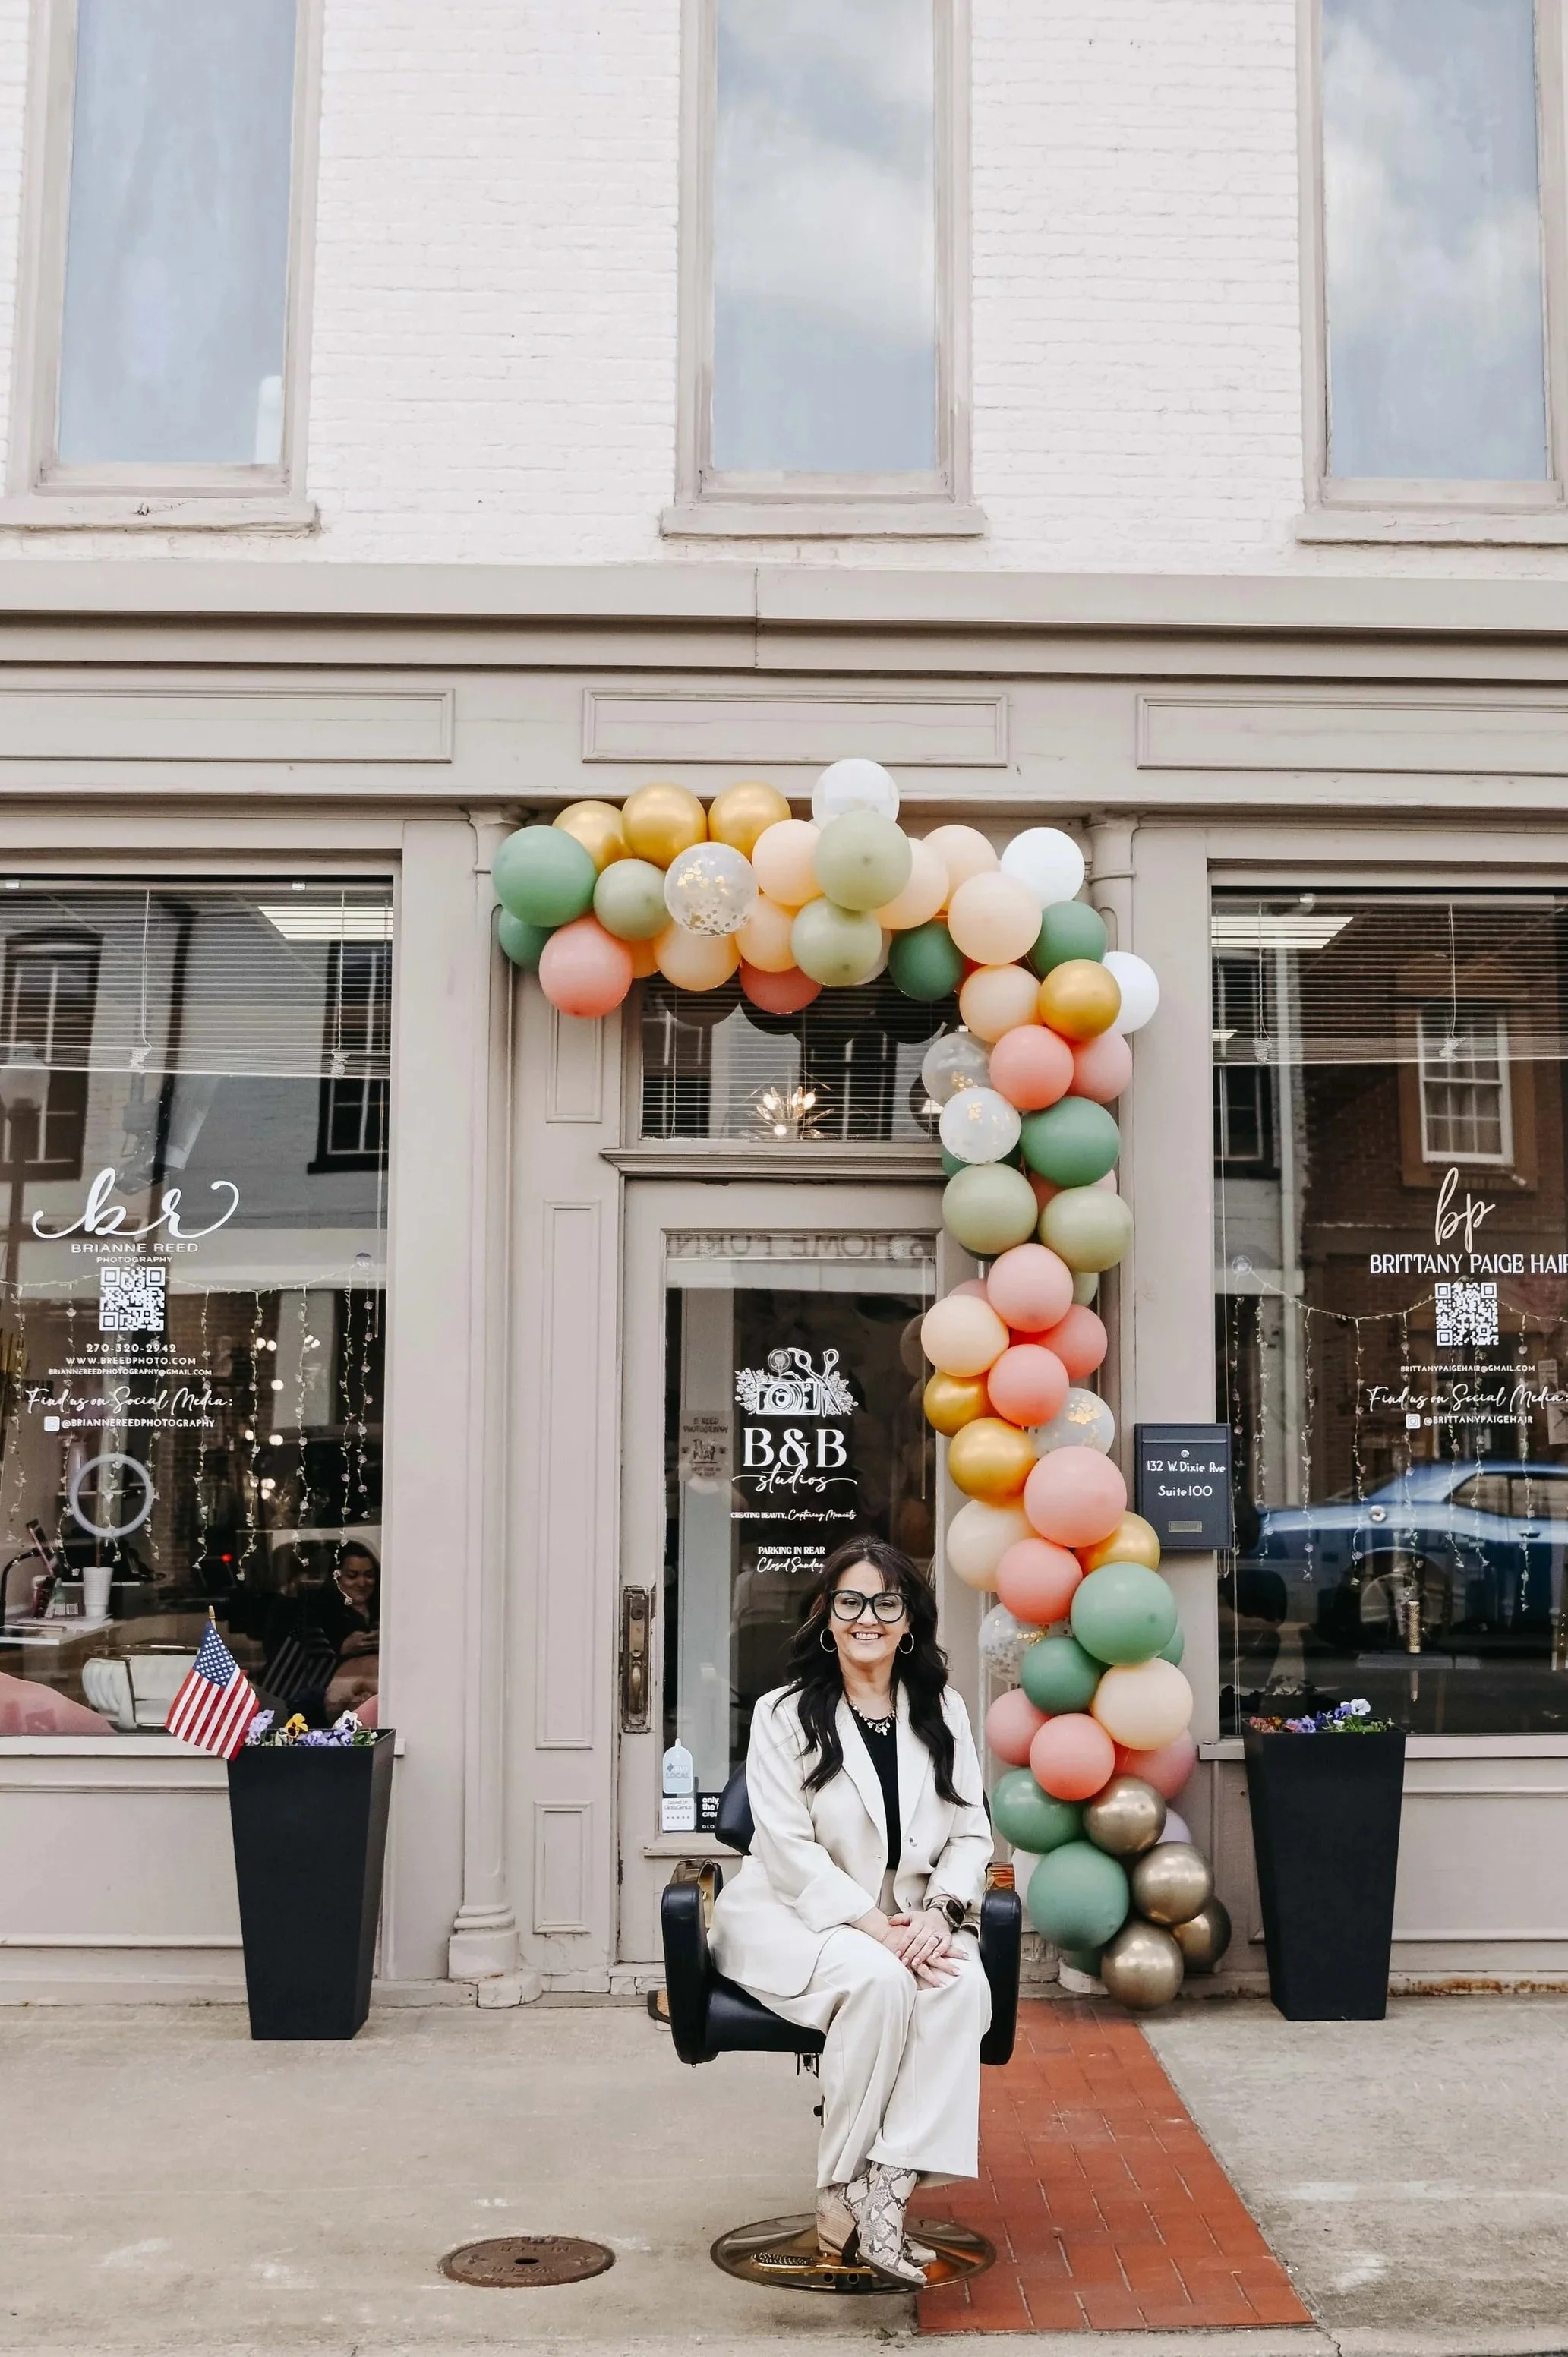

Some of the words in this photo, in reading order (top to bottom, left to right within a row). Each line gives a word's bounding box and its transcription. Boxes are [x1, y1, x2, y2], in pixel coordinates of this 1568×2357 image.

[32, 1167, 240, 1239] br
[1435, 1166, 1496, 1254] bp
[71, 1243, 147, 1253] BRIANNE
[153, 1243, 199, 1253] REED
[1370, 1254, 1462, 1274] BRITTANY
[1470, 1254, 1524, 1274] PAIGE
[86, 1343, 177, 1353] 270-320-2942
[66, 1357, 196, 1365] WWW.BREEDPHOTO.COM
[1400, 1365, 1535, 1373] BRITTANYPAIGEHAIR@GMAIL.COM
[25, 1387, 69, 1414] Find
[69, 1397, 90, 1412] us
[90, 1397, 110, 1406] on
[109, 1386, 168, 1414] Social
[170, 1387, 232, 1415] Media:
[1366, 1385, 1409, 1412] Find
[1409, 1395, 1428, 1409] us
[1430, 1396, 1449, 1405] on
[1451, 1384, 1506, 1411] Social
[62, 1418, 215, 1428] @BRIANNEREEDPHOTOGRAPHY
[1424, 1416, 1533, 1425] @BRITTANYPAIGEHAIR
[743, 1428, 847, 1469] B&B
[1147, 1460, 1163, 1472] 132
[1179, 1461, 1205, 1472] Dixie
[1209, 1462, 1226, 1472] Ave
[732, 1462, 857, 1494] studios
[1157, 1485, 1187, 1497] Suite
[1188, 1485, 1213, 1497] 100
[787, 1509, 825, 1522] Capturing
[825, 1509, 857, 1522] Moments
[758, 1546, 792, 1554] PARKING
[793, 1546, 802, 1554] IN
[803, 1546, 825, 1554] REAR
[757, 1557, 791, 1573] Closed
